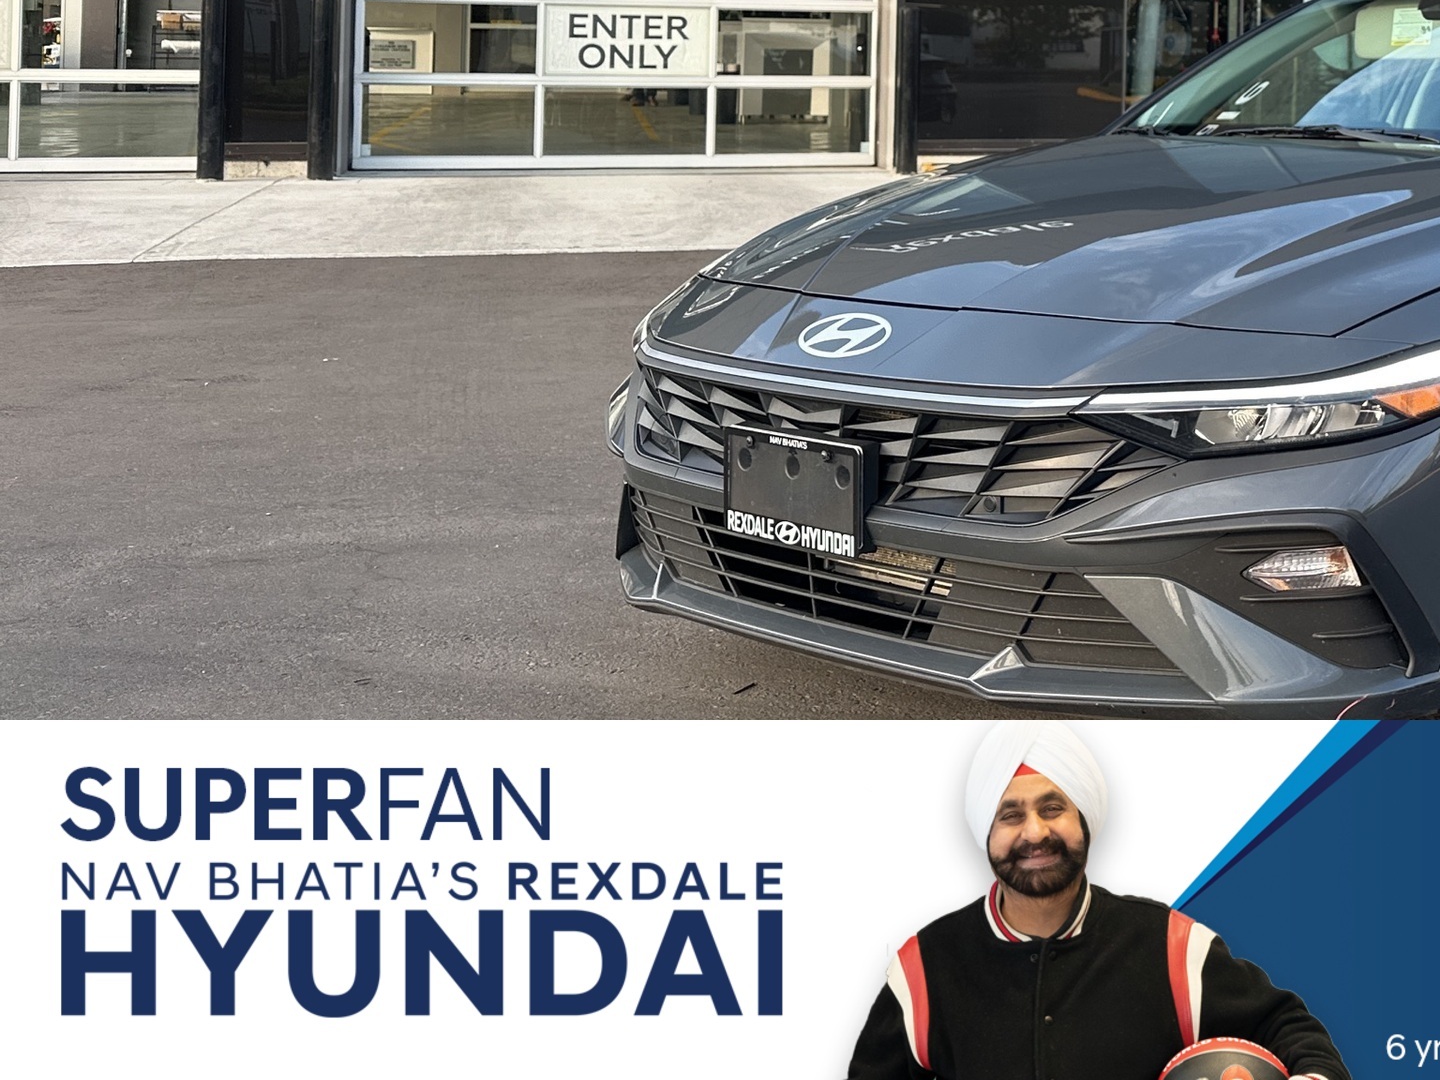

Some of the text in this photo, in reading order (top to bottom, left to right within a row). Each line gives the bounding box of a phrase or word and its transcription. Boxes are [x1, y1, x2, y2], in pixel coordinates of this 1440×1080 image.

[568, 13, 690, 40] ENTER
[578, 43, 678, 69] ONLY
[727, 509, 855, 558] REXDALE HYUNDAI
